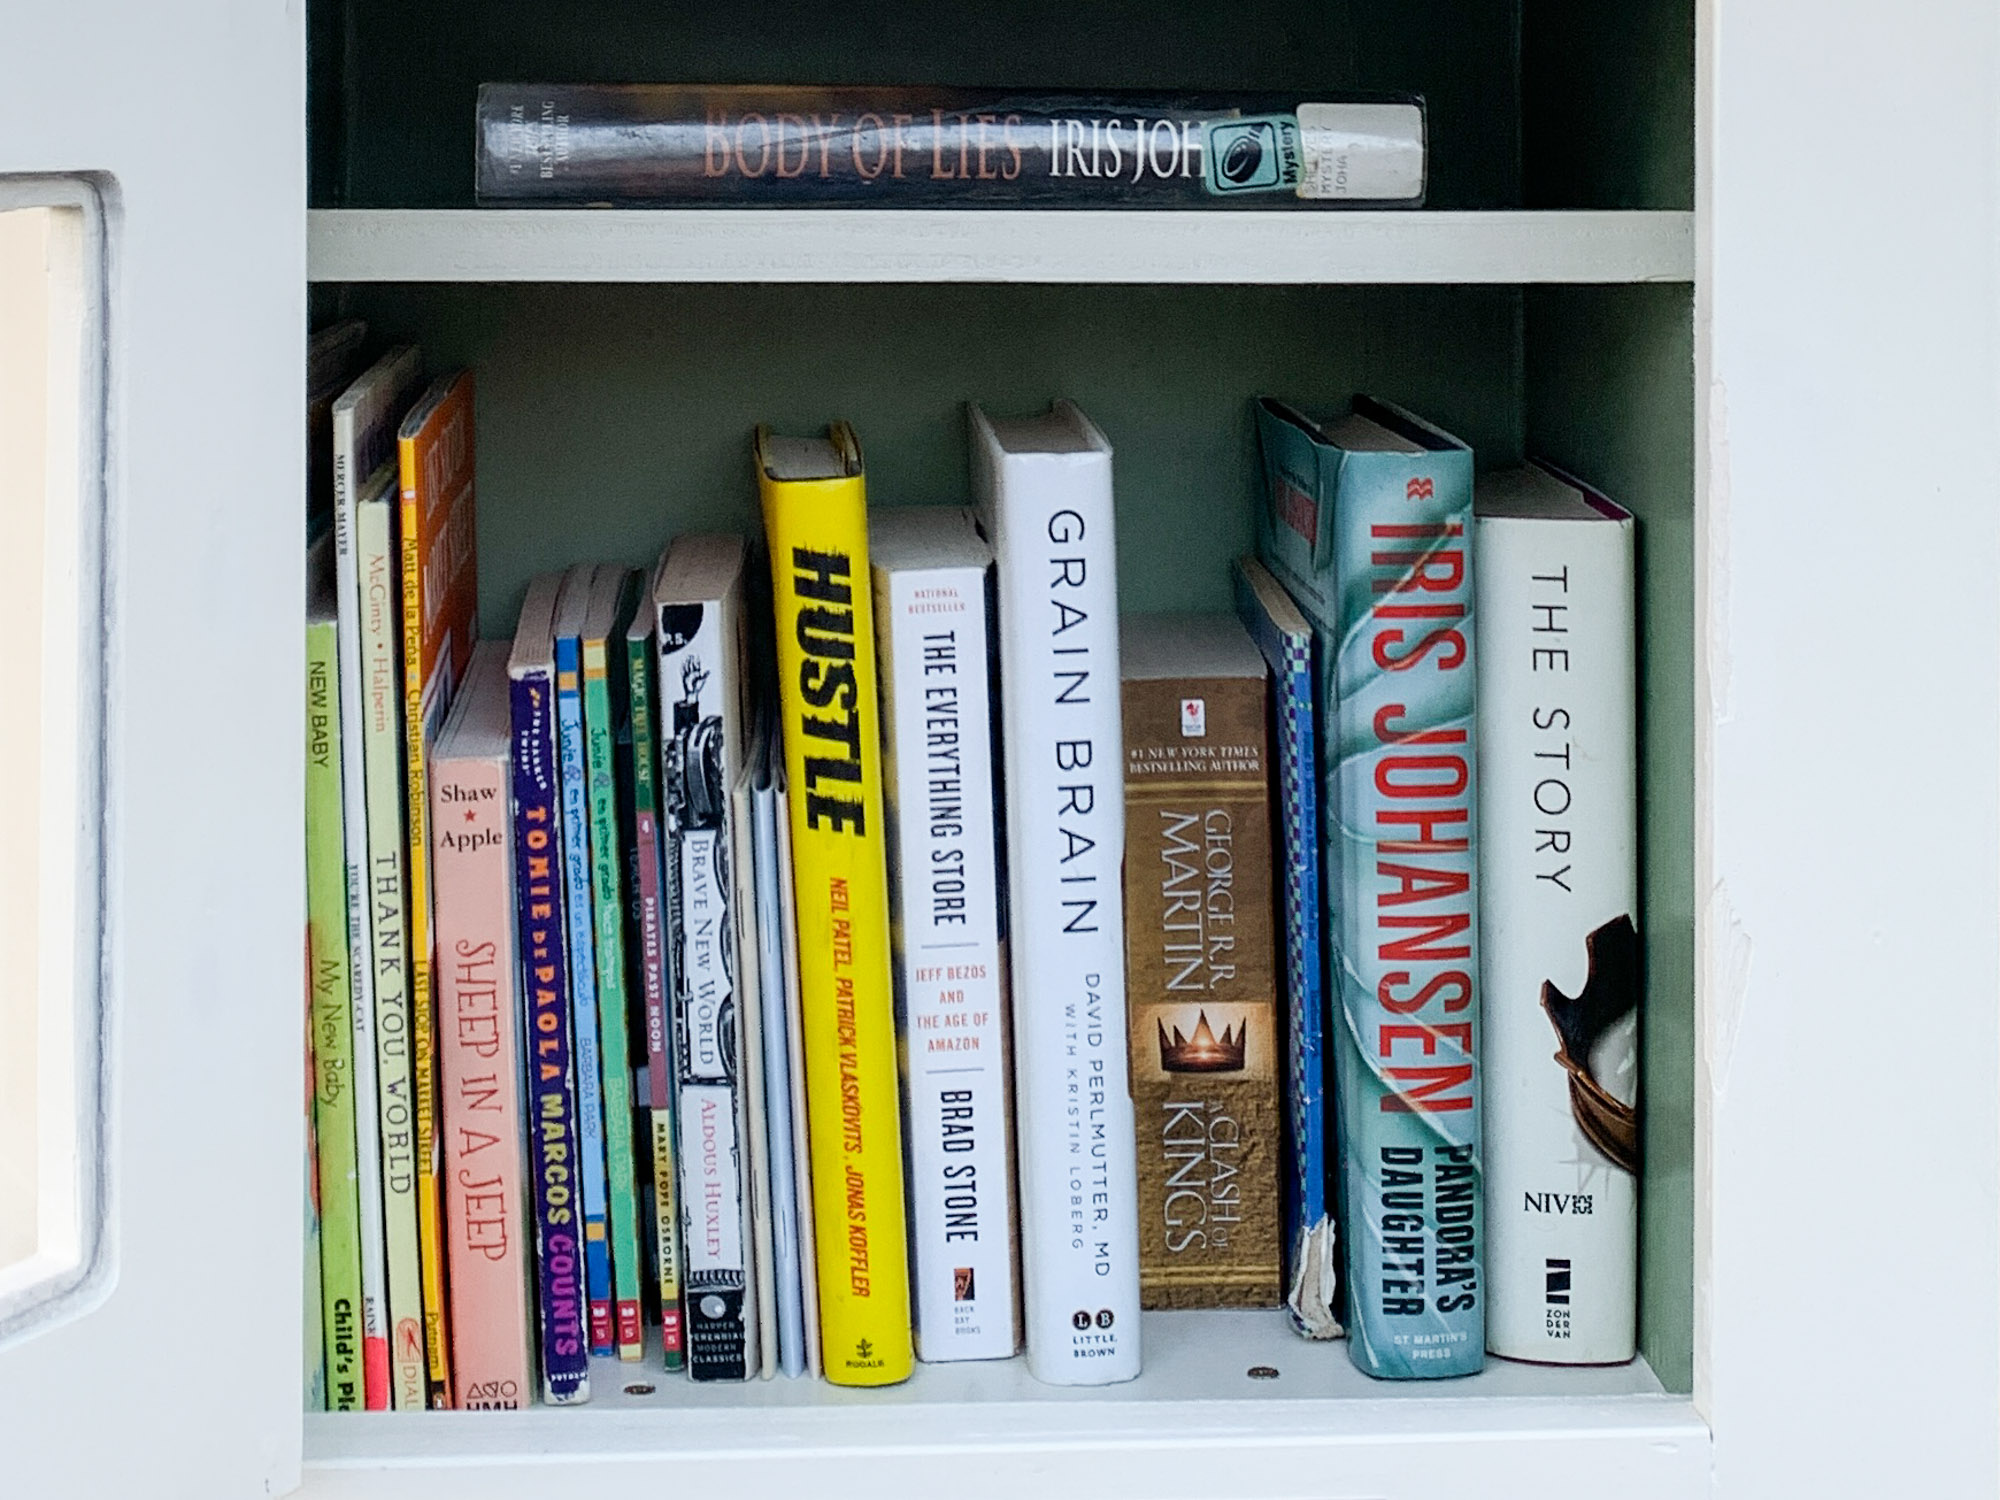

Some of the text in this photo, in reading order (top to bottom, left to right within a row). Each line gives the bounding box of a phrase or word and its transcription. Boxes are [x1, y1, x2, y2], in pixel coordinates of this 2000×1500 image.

[704, 109, 1020, 180] BODY OF LIES
[1049, 118, 1121, 178] IRIS
[1280, 121, 1299, 184] Mystery
[334, 454, 348, 555] MERCER MAYER
[403, 537, 419, 572] Matt
[403, 580, 418, 599] de
[405, 605, 419, 620] la
[914, 588, 959, 598] NATIONAL
[369, 553, 389, 733] McGinty Halperin
[310, 660, 329, 769] NEW BABY
[630, 657, 647, 702] MAGIC
[792, 545, 866, 838] HUSTLE
[560, 719, 580, 763] Junie
[590, 727, 608, 769] Junie
[1047, 510, 1099, 934] GRAIN BRAIN
[1148, 746, 1177, 758] NEW
[1182, 746, 1216, 758] YORK
[1220, 745, 1259, 758] TIMES
[1531, 565, 1572, 893] THE STORY
[408, 688, 426, 846] Christian Robinson
[440, 785, 497, 803] Shaw
[636, 739, 652, 780] HOUSE
[922, 630, 967, 927] THE EVERYTHING STORE
[1129, 758, 1260, 774] BESTSELLING AUTHOR
[440, 828, 503, 853] Apple
[1371, 523, 1474, 1114] IRIS JOHANSEN
[525, 806, 553, 920] TOMIE
[829, 877, 850, 914] NEIL
[1204, 810, 1234, 928] GEORGE
[350, 915, 361, 940] THE
[376, 851, 402, 976] THANK
[1160, 811, 1205, 990] MARTIN
[414, 960, 431, 991] LAST
[643, 897, 662, 1053] PIRATES PAST NOON
[691, 839, 718, 1067] BRAVE NEW WORLD
[915, 964, 987, 982] JEFF BEZOS
[415, 1000, 432, 1034] STOP
[534, 965, 562, 1083] PAOLA
[835, 977, 857, 1050] PATRICK
[917, 1012, 989, 1029] THE AGE OF
[939, 990, 965, 1004] AND
[316, 959, 345, 1109] My New Baby
[416, 1037, 432, 1061] ON
[927, 1036, 980, 1053] AMAZON
[455, 940, 508, 1263] SHEEP IN A JEEP
[580, 1037, 597, 1140] BARBARA PARK
[608, 1077, 624, 1147] BARBARA
[386, 1076, 412, 1196] WORLD
[419, 1126, 434, 1176] STREET
[539, 1093, 572, 1226] MARCOS
[1065, 1003, 1085, 1249] WITH KRISTIN LOBERG
[1085, 973, 1103, 1048] DAVID
[1094, 1242, 1111, 1277] MD
[701, 1098, 723, 1261] ALDOUS HUXLEY
[844, 1165, 867, 1222] JONAS
[939, 1090, 979, 1244] BRAD STONE
[1162, 1101, 1207, 1251] KINGS
[1209, 1116, 1241, 1222] CLASH
[656, 1122, 675, 1284] MARY POPE OSBORNE
[1380, 1146, 1425, 1317] DAUGHTER
[1435, 1143, 1477, 1314] PANDORA'S
[1524, 1191, 1571, 1215] NIV
[548, 1234, 580, 1357] COUNTS
[848, 1224, 871, 1298] KOFFLER
[335, 1299, 354, 1374] Child's
[426, 1311, 441, 1369] Putnam
[1545, 1320, 1570, 1329] DER
[1546, 1310, 1571, 1319] ZON
[1546, 1330, 1571, 1339] VAN
[402, 1364, 421, 1408] DIAL
[1073, 1347, 1115, 1358] BROWN
[1412, 1347, 1451, 1360] PRESS
